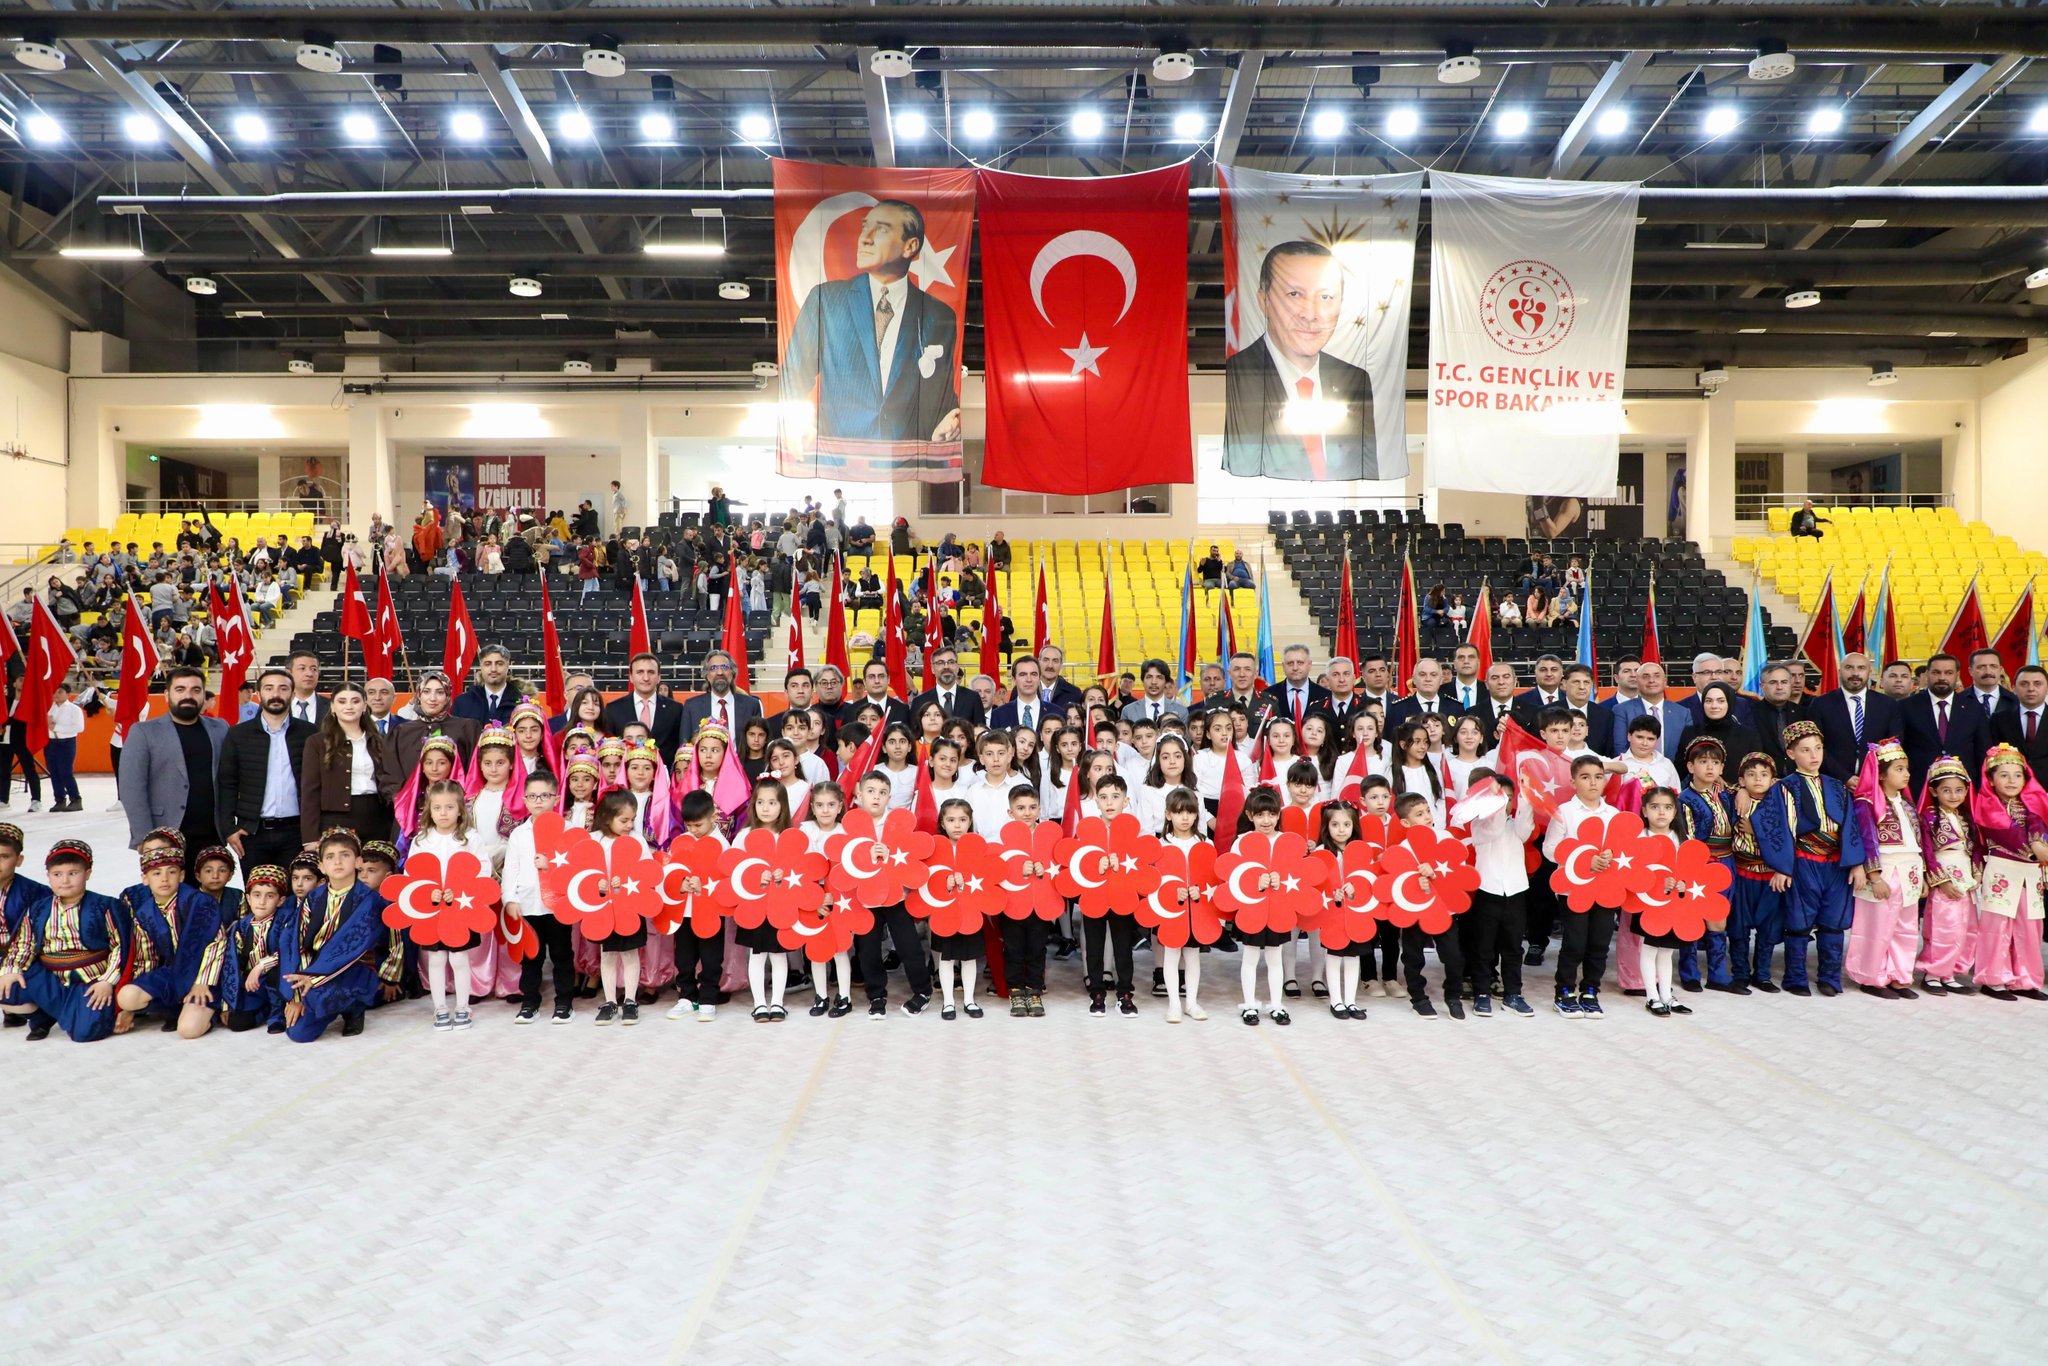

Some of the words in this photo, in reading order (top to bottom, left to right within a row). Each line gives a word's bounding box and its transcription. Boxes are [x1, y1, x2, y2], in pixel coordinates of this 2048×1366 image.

[1435, 362, 1473, 382] T.C.
[1479, 366, 1580, 391] GENÇLİK
[1588, 371, 1616, 390] VE
[1434, 389, 1489, 409] SPOR
